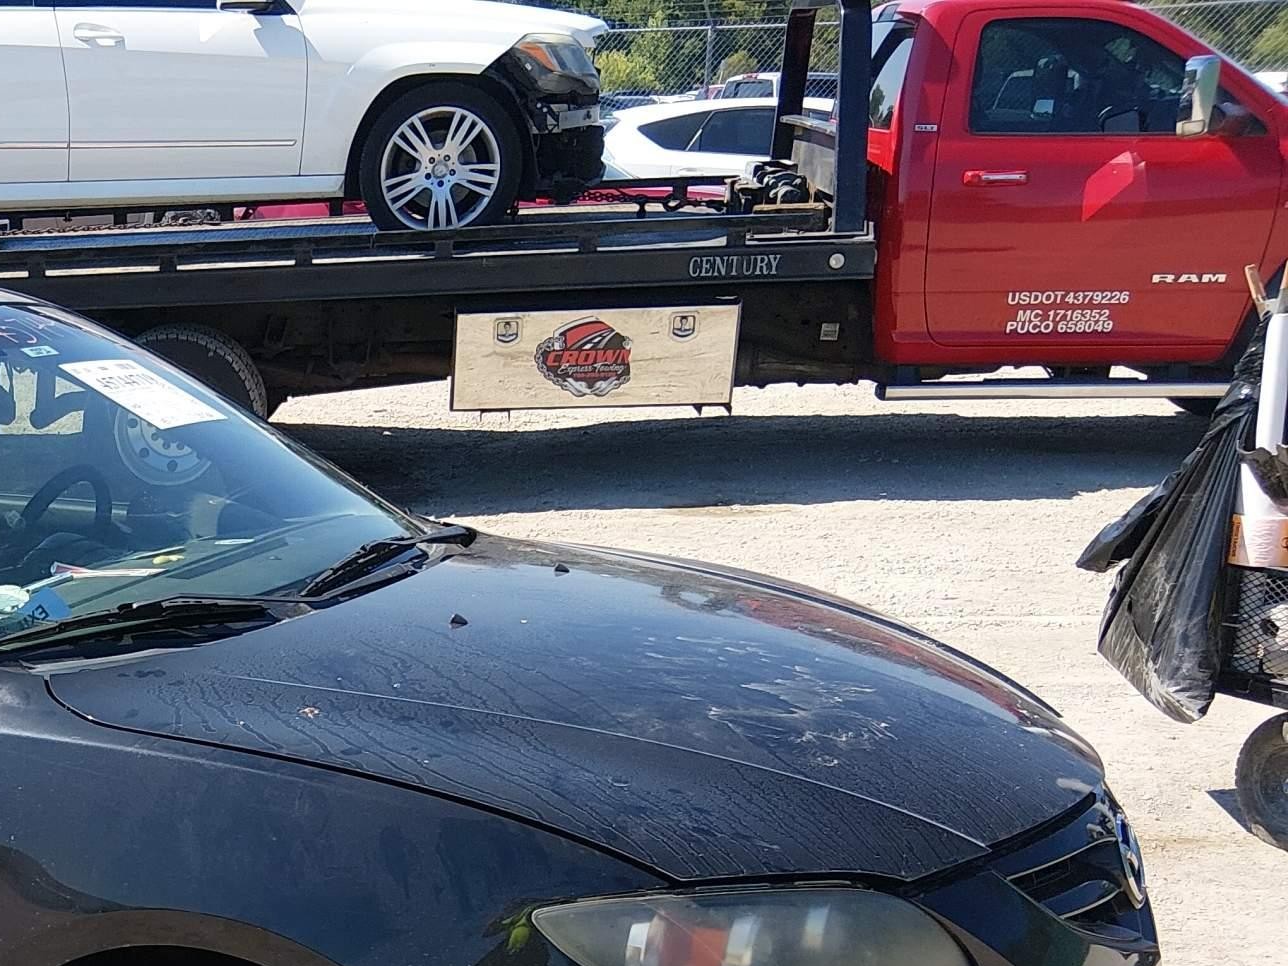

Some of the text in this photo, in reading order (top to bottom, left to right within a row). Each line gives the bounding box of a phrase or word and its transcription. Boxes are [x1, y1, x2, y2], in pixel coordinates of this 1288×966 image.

[688, 254, 782, 277] CENTURY
[1151, 273, 1227, 283] RAM
[1007, 291, 1130, 305] USDOT 4379226
[1016, 309, 1109, 322] MC 1716352
[1006, 320, 1113, 334] PUCO 658049
[547, 350, 630, 366] CROWN
